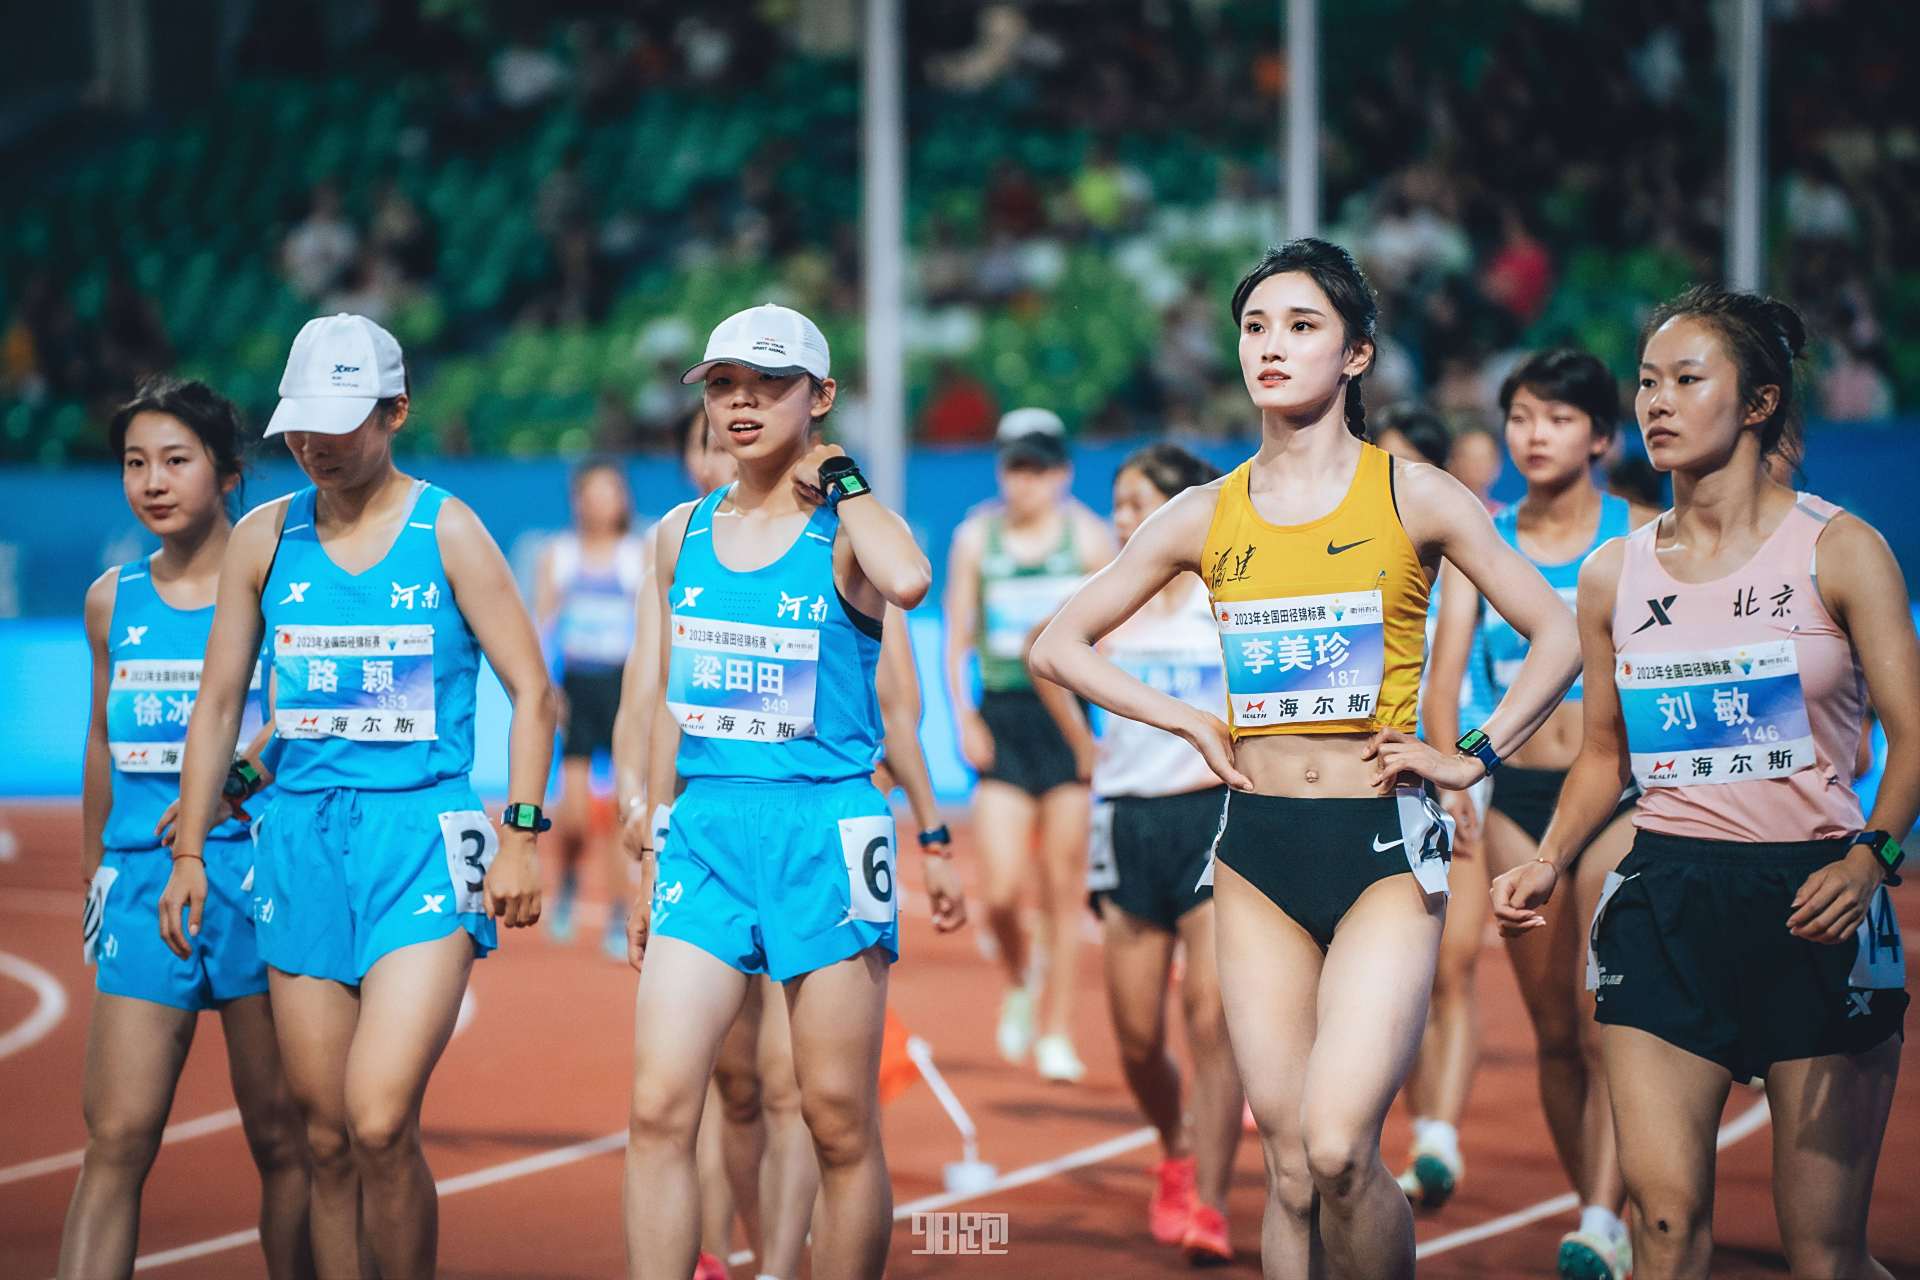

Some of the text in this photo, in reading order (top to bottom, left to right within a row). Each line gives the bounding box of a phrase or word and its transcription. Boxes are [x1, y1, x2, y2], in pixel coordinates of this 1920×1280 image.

[390, 581, 440, 610] 河南
[776, 591, 829, 623] 河南
[1733, 584, 1795, 618] 北京
[1234, 606, 1327, 626] 2023年全国田径锦标赛
[1241, 632, 1350, 675] 李美珍
[692, 655, 784, 696] 梁田田
[1327, 669, 1360, 687] 187
[1636, 659, 1733, 680] 2023年全国田径锦标赛
[376, 695, 408, 710] 353
[761, 697, 790, 713] 349
[1656, 687, 1755, 732] 刘敏
[1742, 725, 1780, 743] 146
[460, 829, 487, 893] 3
[862, 836, 893, 903] 6
